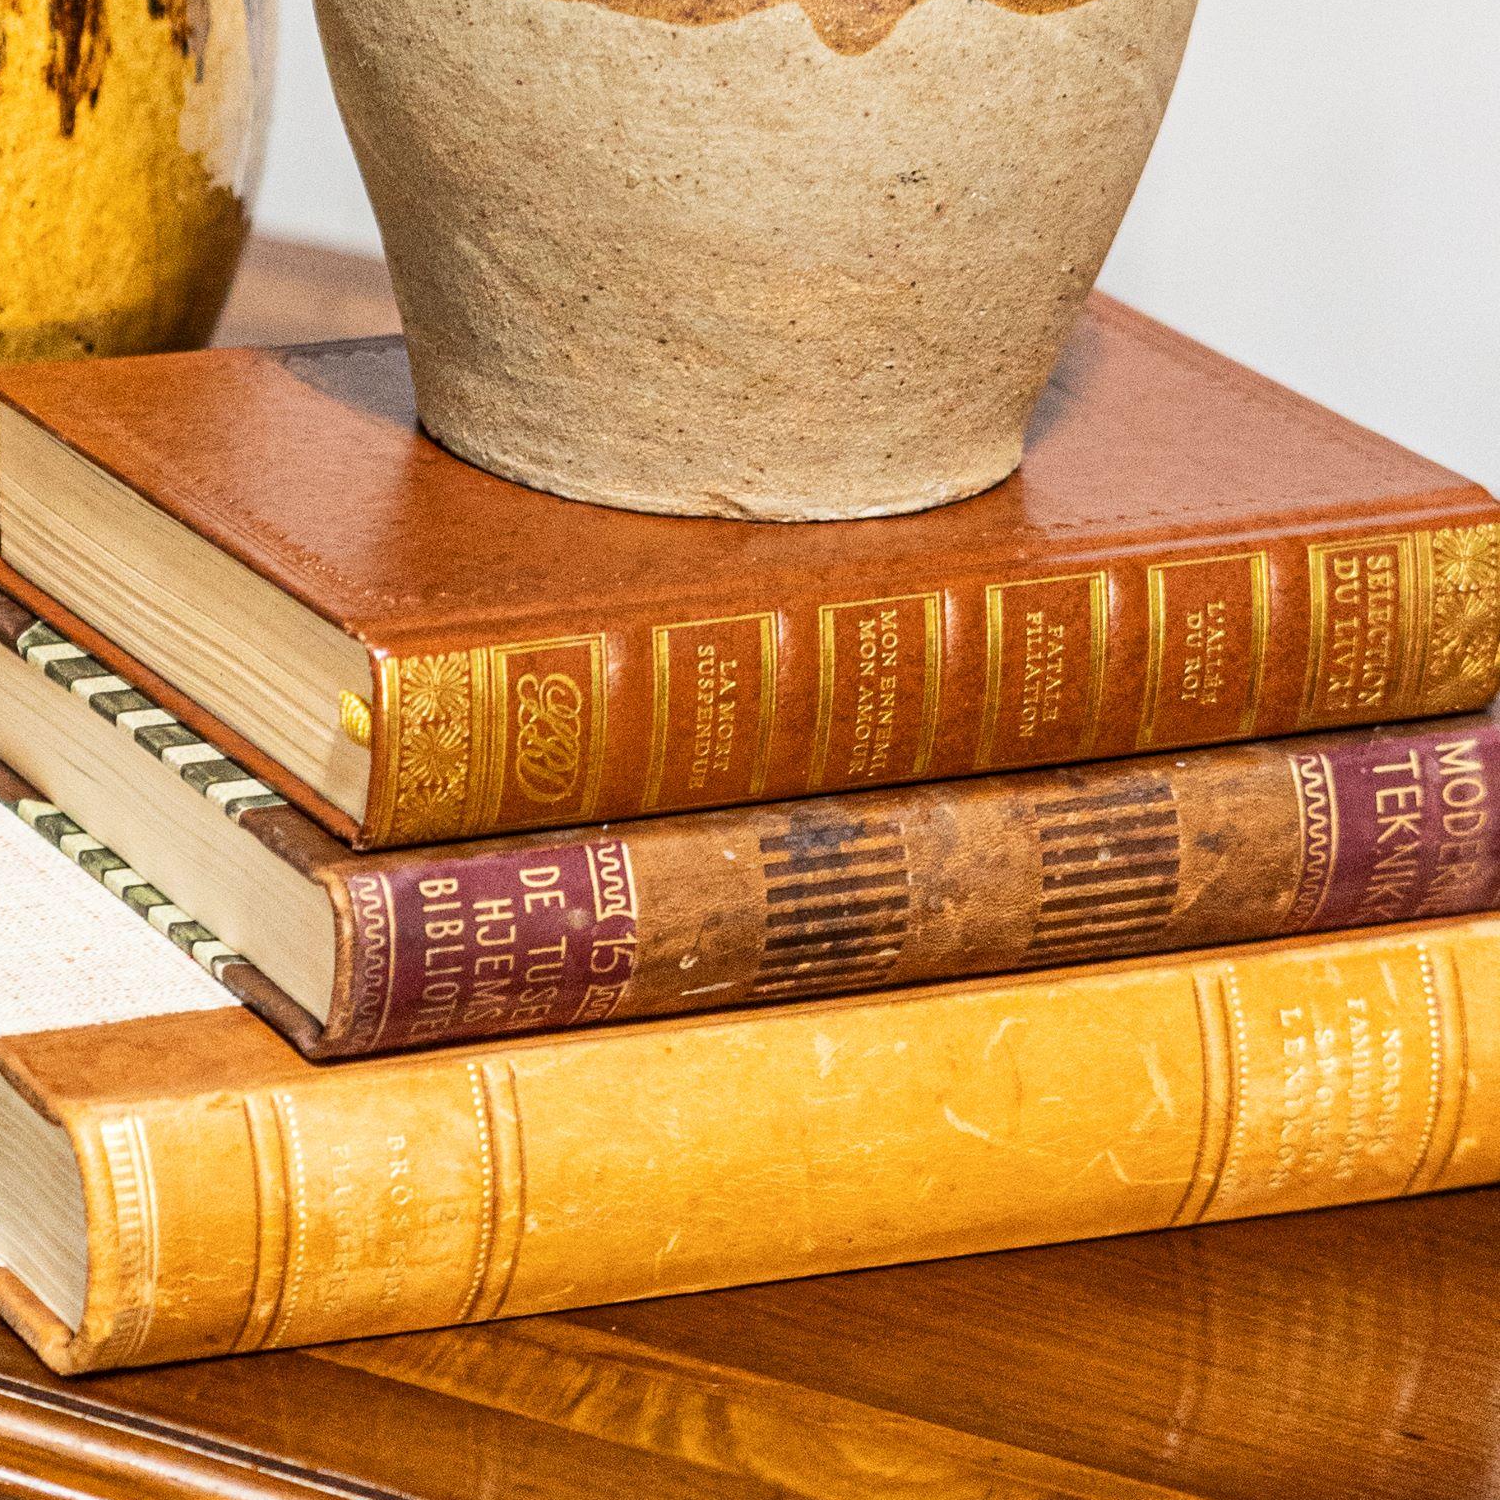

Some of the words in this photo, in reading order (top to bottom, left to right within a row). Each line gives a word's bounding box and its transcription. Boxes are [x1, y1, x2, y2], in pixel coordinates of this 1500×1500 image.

[1334, 556, 1360, 604] DU
[859, 619, 876, 676] MON
[880, 609, 898, 666] MON
[1186, 612, 1202, 648] DU
[719, 659, 737, 695] LA
[1019, 611, 1043, 738] FILIATION
[1042, 624, 1064, 722] FATALE
[1181, 656, 1202, 701] ROI
[688, 644, 715, 790] SUSPENDUE
[713, 701, 735, 771] MORT
[848, 685, 874, 775] AMOUR
[520, 866, 566, 914] DE
[462, 898, 516, 1023] HJEMS
[590, 932, 640, 973] 15
[1268, 1006, 1306, 1190] LEXIKON
